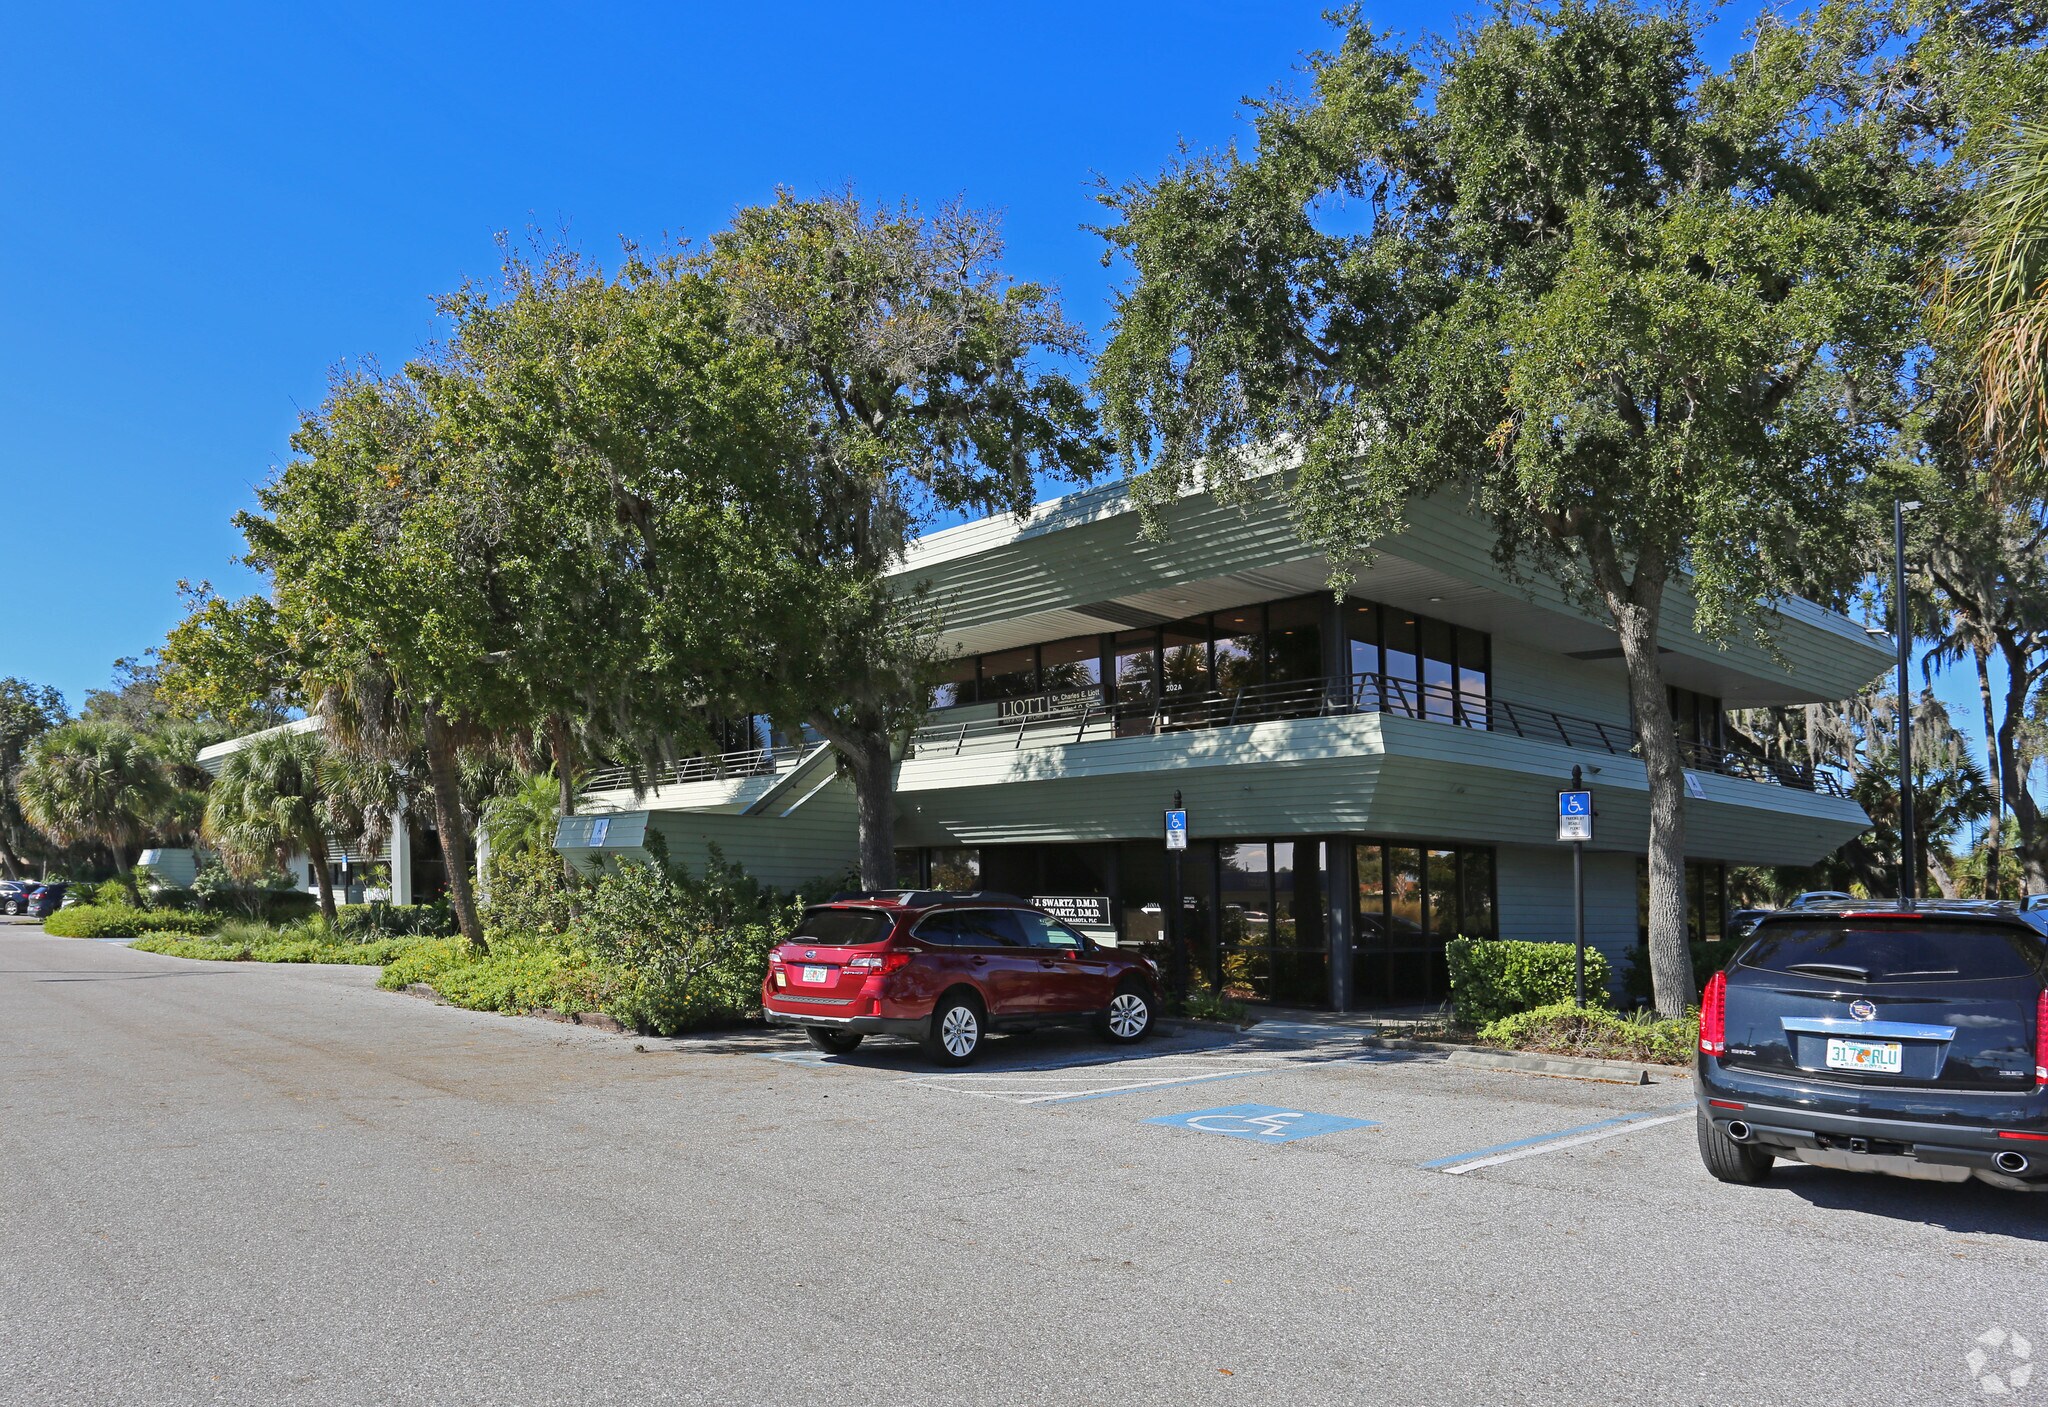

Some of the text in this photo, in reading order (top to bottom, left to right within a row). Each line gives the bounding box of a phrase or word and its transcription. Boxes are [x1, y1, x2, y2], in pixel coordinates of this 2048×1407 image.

[1166, 683, 1182, 692] 202A
[1060, 692, 1080, 701] Charles
[1087, 688, 1100, 697] Liott
[1001, 696, 1045, 717] LIOTT
[1042, 898, 1075, 908] SWARTZ,
[1076, 899, 1099, 908] D.M.D.
[1078, 908, 1101, 917] D.M.D.
[1872, 1049, 1897, 1065] RLU
